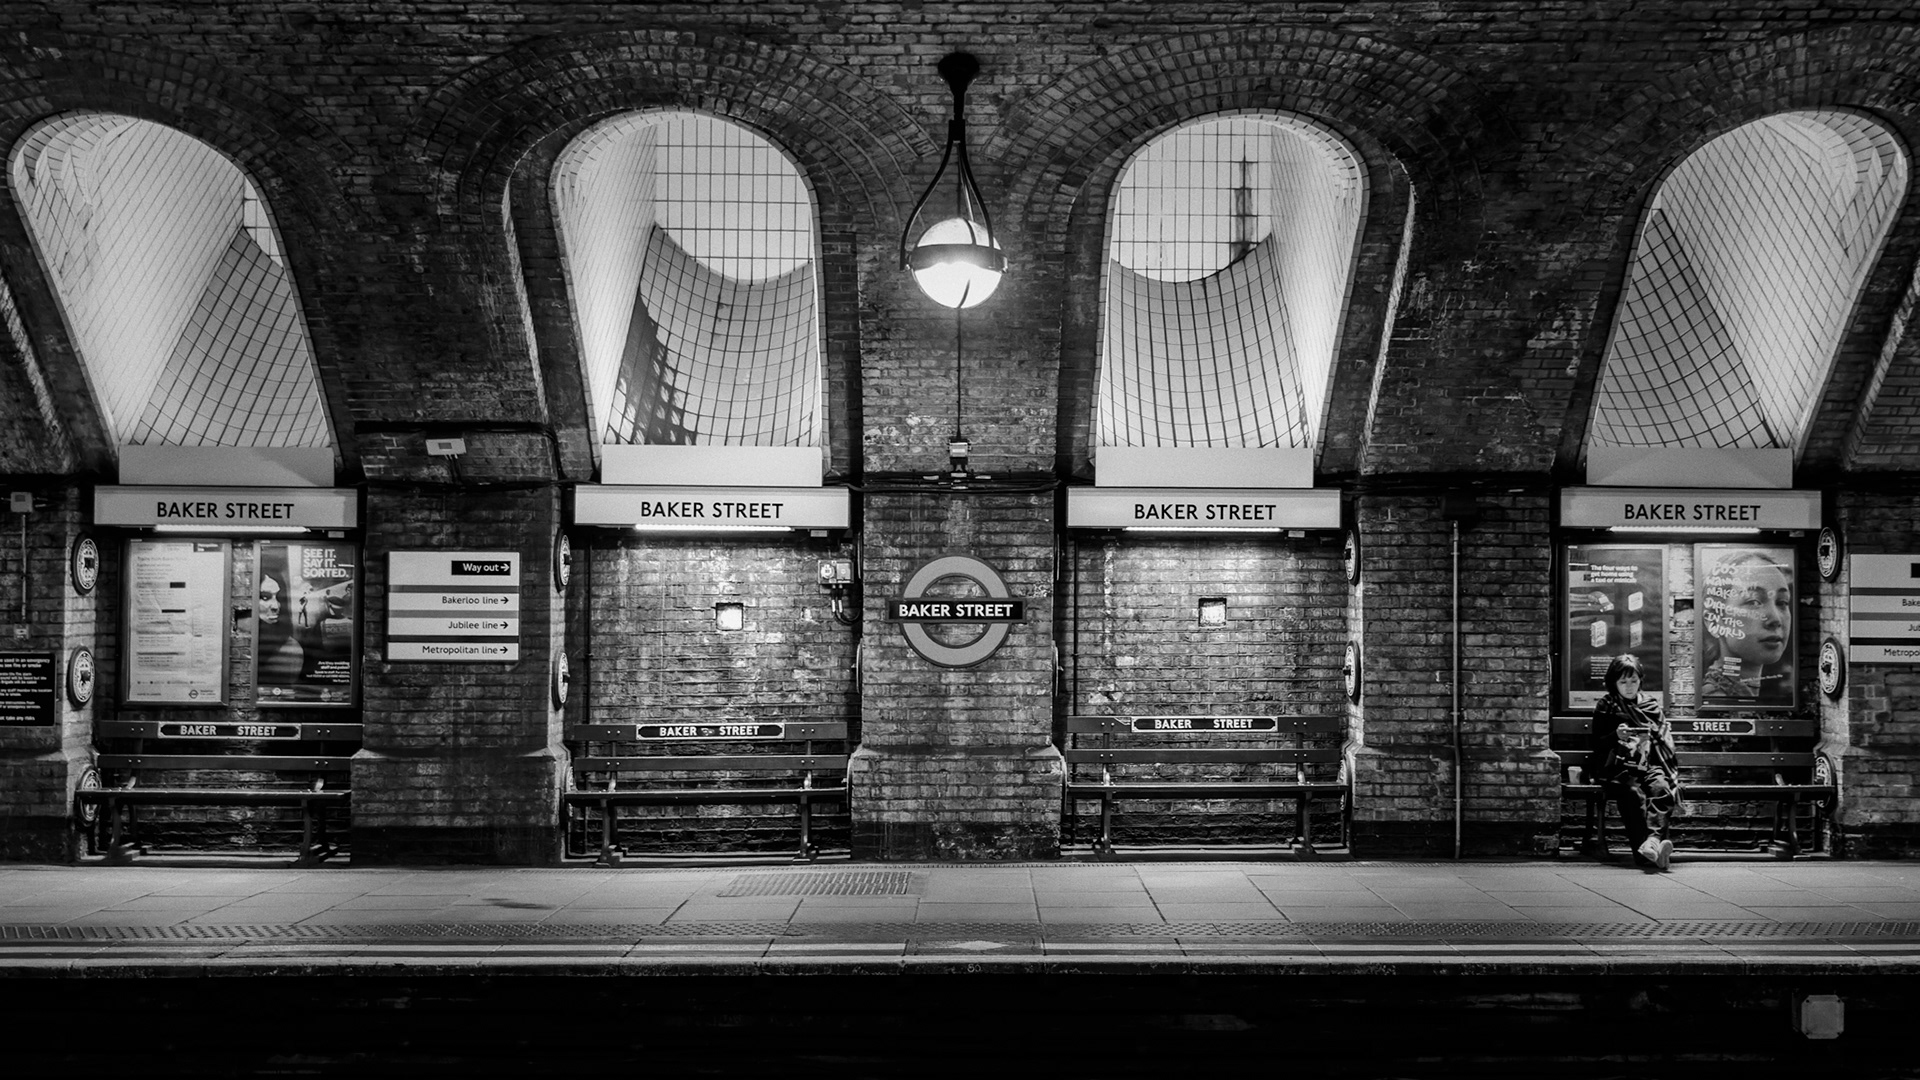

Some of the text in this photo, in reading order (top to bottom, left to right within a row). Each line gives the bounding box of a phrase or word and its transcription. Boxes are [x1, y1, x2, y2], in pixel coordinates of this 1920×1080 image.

[157, 502, 295, 518] BAKER STREET
[641, 501, 784, 518] BAKER STREET
[1134, 503, 1277, 520] BAKER STREET
[1624, 503, 1761, 520] BAKER STREET
[303, 548, 337, 558] SEE IT.
[303, 559, 337, 568] SAY IT.
[462, 563, 499, 574] Way out
[303, 568, 350, 578] SORTED.
[441, 596, 499, 605] Bakerloo line
[898, 604, 1014, 617] BAKER STREET
[447, 621, 499, 630] Jubilee line
[422, 645, 498, 656] Metropolitan line
[1154, 719, 1253, 730] BAKER STREET
[1692, 721, 1732, 732] STREET
[180, 725, 277, 736] BAKER STREET
[659, 725, 760, 737] BAKER STREET
